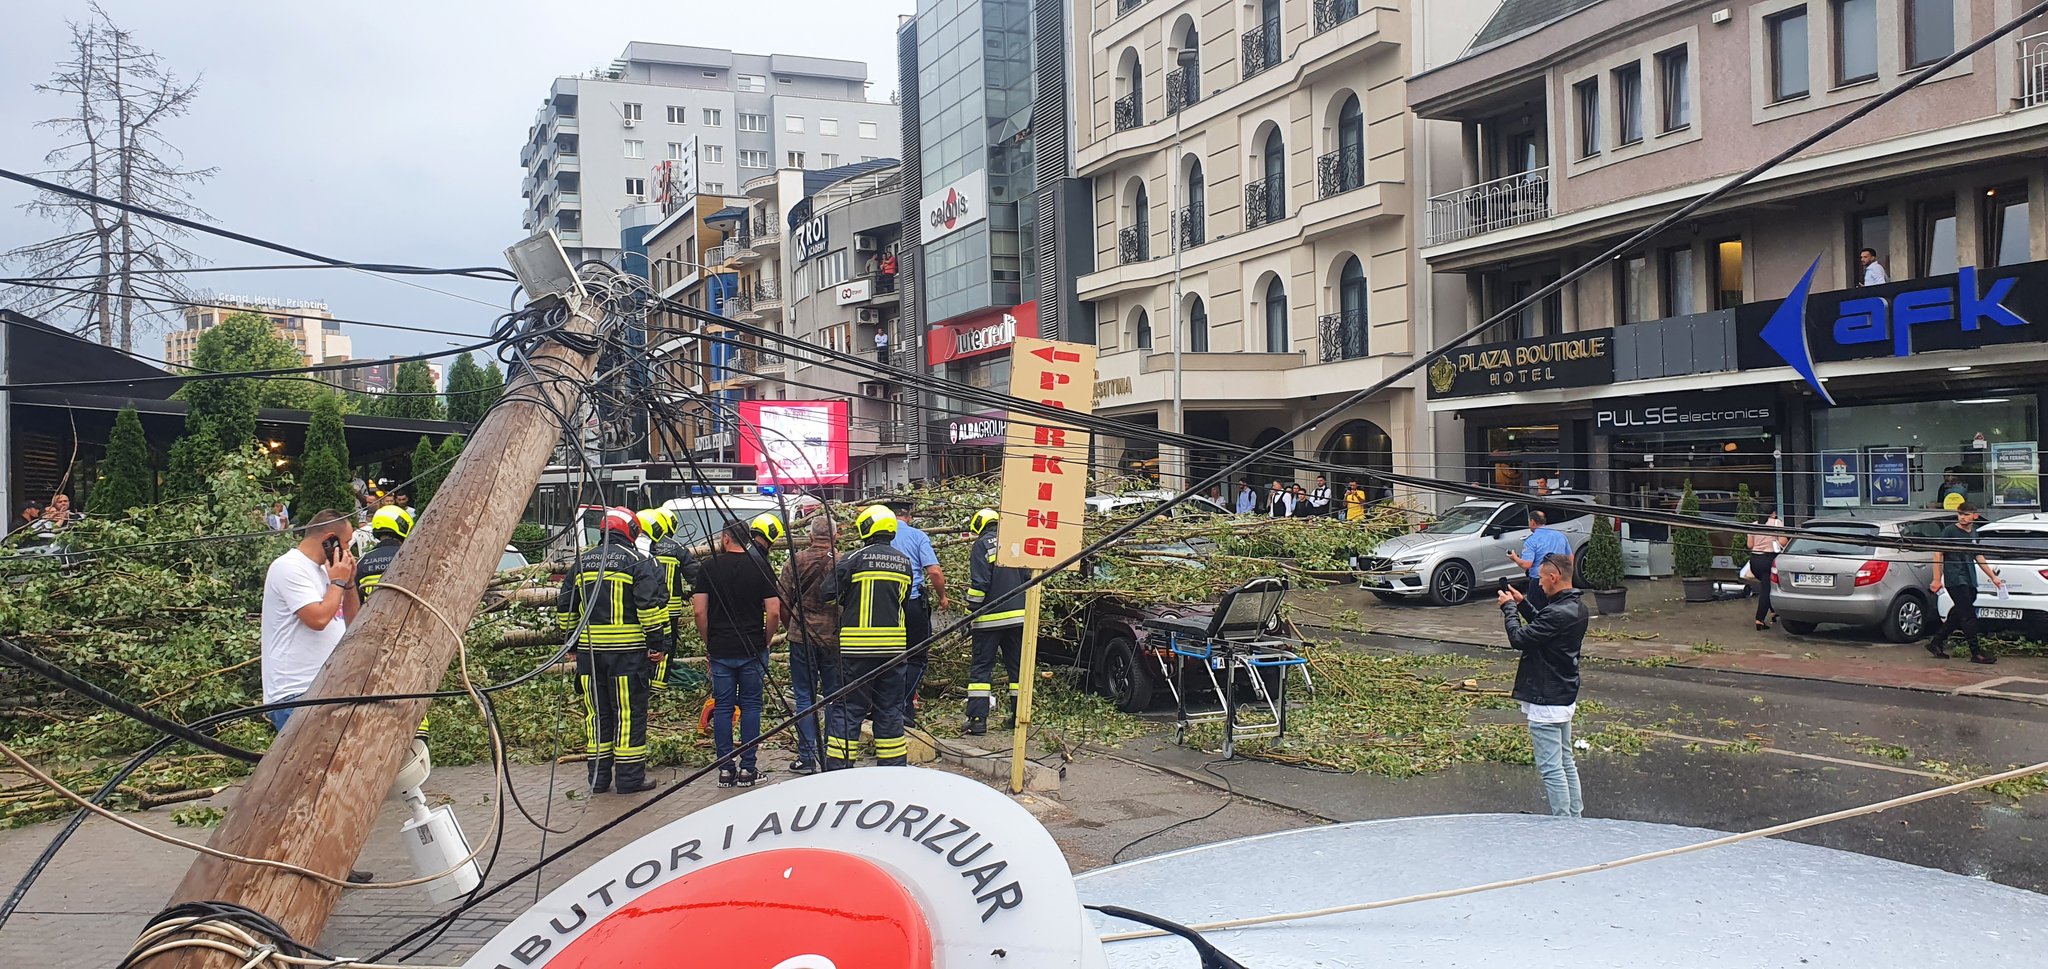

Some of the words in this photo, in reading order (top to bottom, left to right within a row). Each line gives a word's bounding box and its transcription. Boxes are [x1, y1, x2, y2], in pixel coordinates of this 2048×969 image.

[930, 192, 968, 228] celonis
[806, 214, 825, 246] ROI
[807, 241, 826, 257] ACADEMY
[218, 292, 249, 303] Grand
[254, 295, 281, 306] Hotel
[286, 297, 329, 310] Prishtina
[1458, 349, 1512, 373] PLAZA
[1515, 336, 1606, 366] BOUTIQUE
[1490, 367, 1556, 386] HOTEL
[1597, 406, 1678, 428] PULSE
[1679, 408, 1770, 424] electronics
[494, 837, 703, 969] BUTOR
[721, 823, 735, 851] I
[747, 798, 1024, 924] AUTORIZUAR
